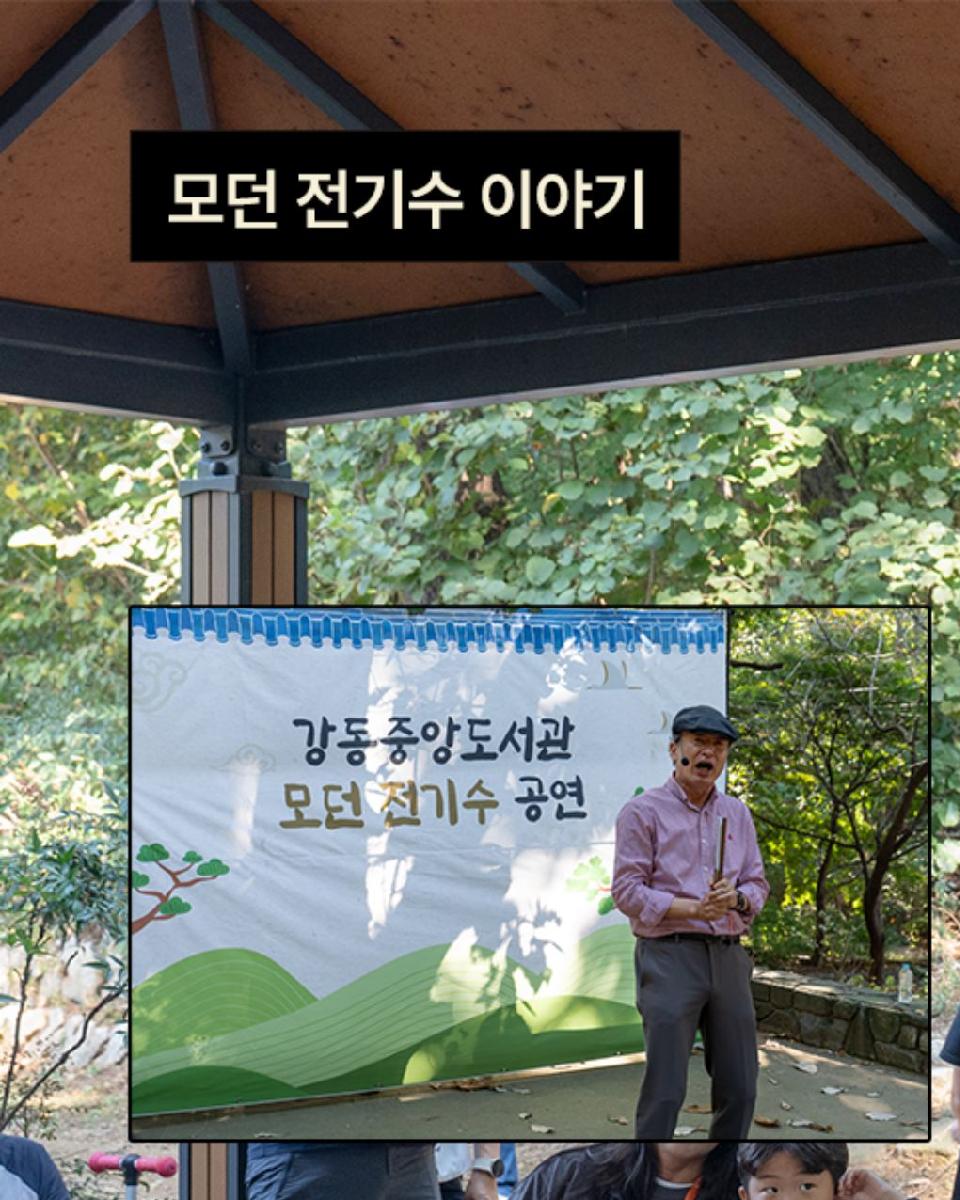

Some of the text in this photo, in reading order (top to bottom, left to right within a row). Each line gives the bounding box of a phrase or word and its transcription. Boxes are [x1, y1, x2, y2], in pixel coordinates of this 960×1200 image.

[293, 716, 575, 766] 강동중앙도서관
[280, 774, 587, 829] 모던 전기수 공연
